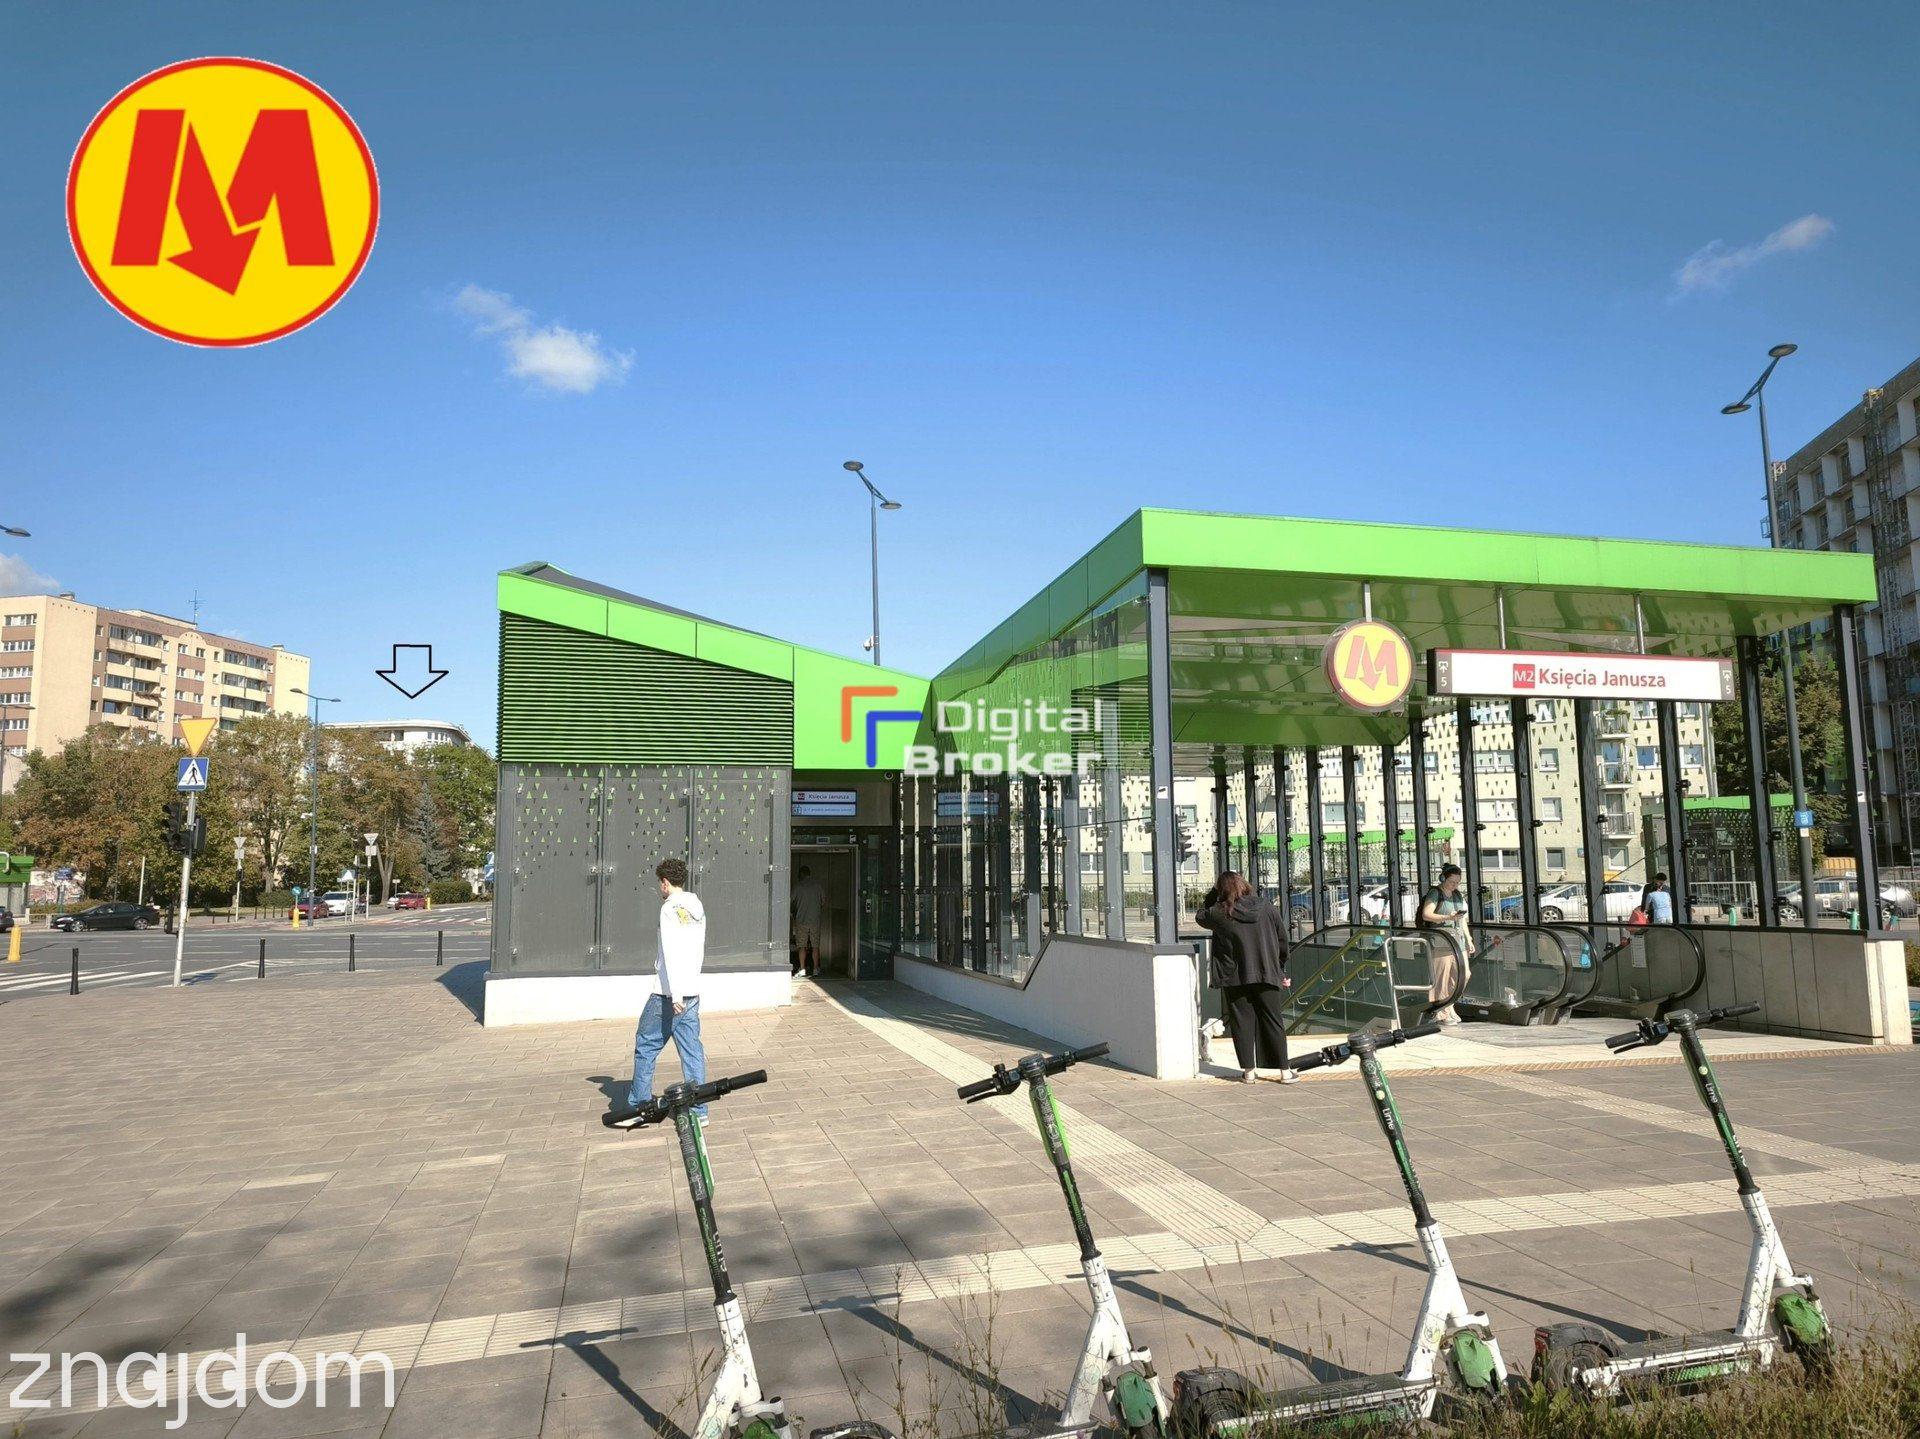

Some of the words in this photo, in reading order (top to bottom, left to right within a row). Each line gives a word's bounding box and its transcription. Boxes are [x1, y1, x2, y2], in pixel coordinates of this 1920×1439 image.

[1344, 635, 1399, 691] M
[1440, 676, 1448, 687] 5
[1514, 669, 1535, 683] M2
[1538, 668, 1597, 690] Księcia
[1602, 669, 1666, 688] Janusza
[1725, 683, 1732, 695] 5
